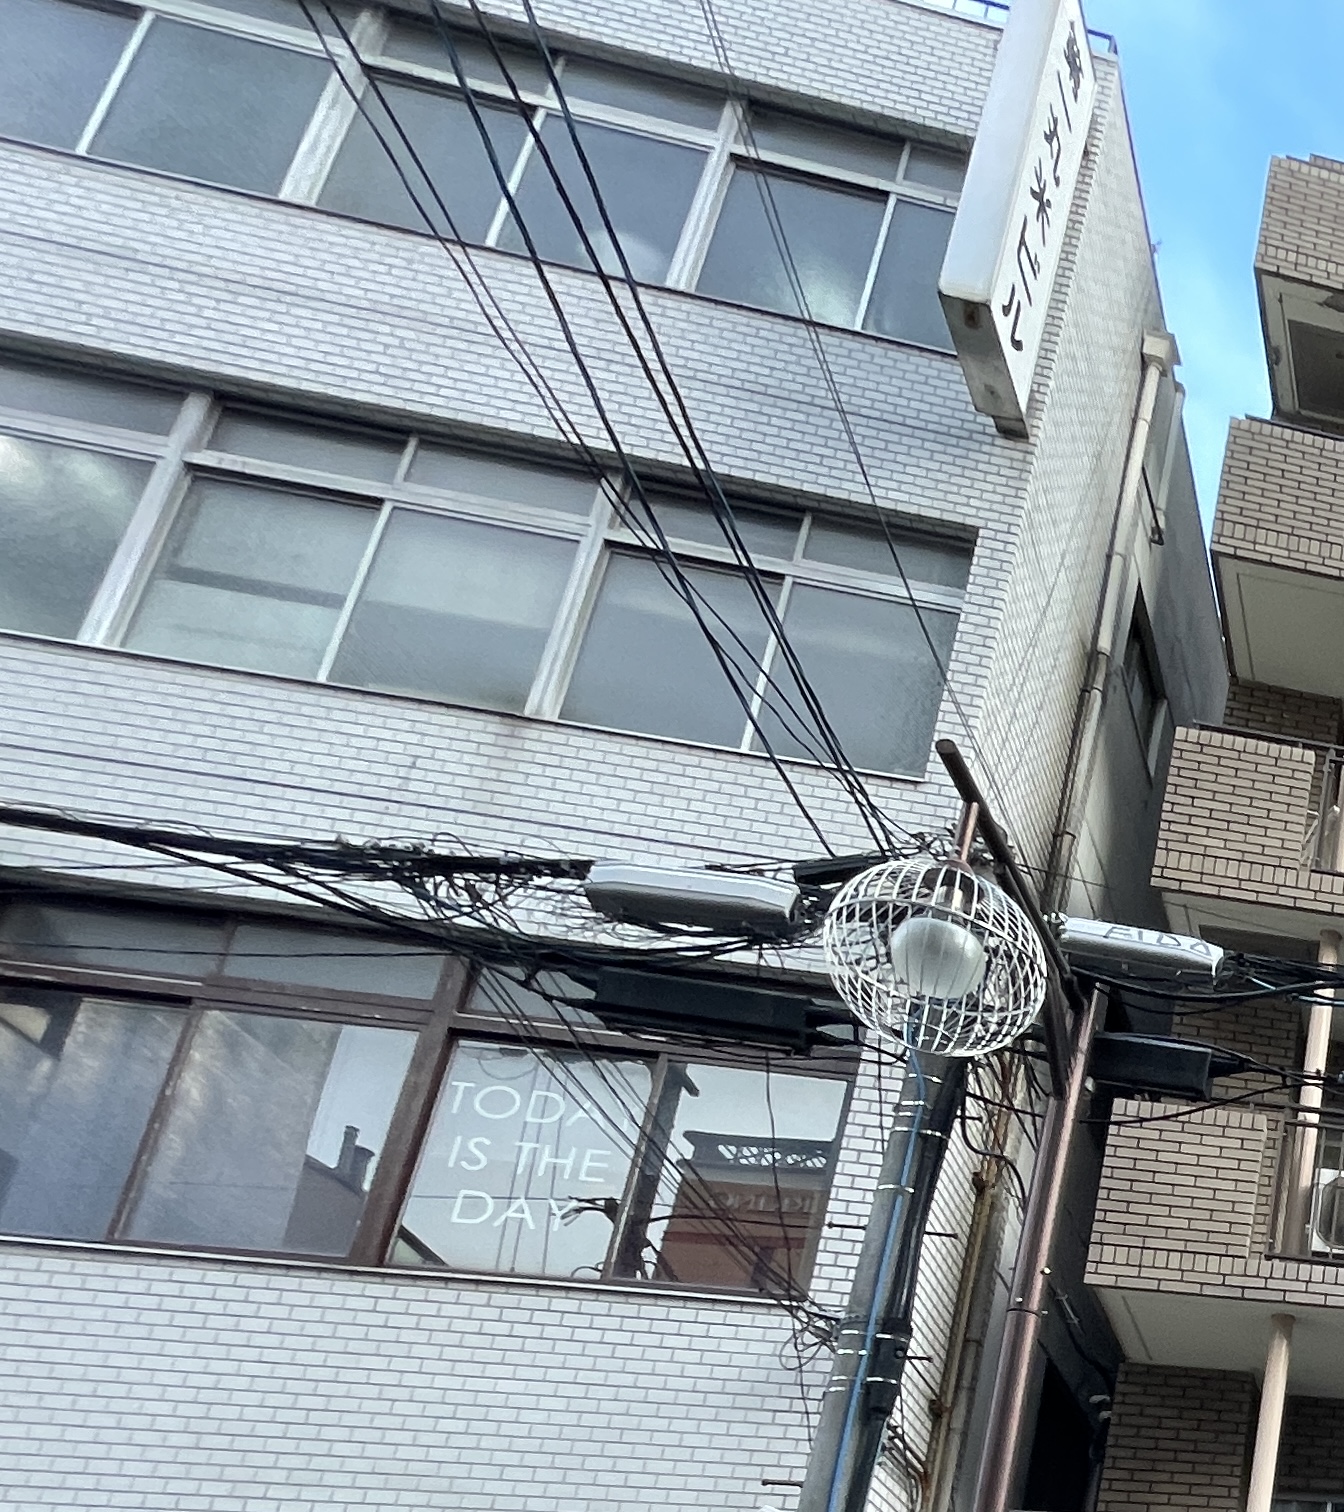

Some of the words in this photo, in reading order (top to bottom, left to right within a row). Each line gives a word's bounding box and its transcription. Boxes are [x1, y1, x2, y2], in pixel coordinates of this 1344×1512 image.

[450, 1081, 632, 1131] TODA
[447, 1136, 493, 1172] IS
[514, 1141, 612, 1183] THE
[450, 1189, 577, 1232] DAY
